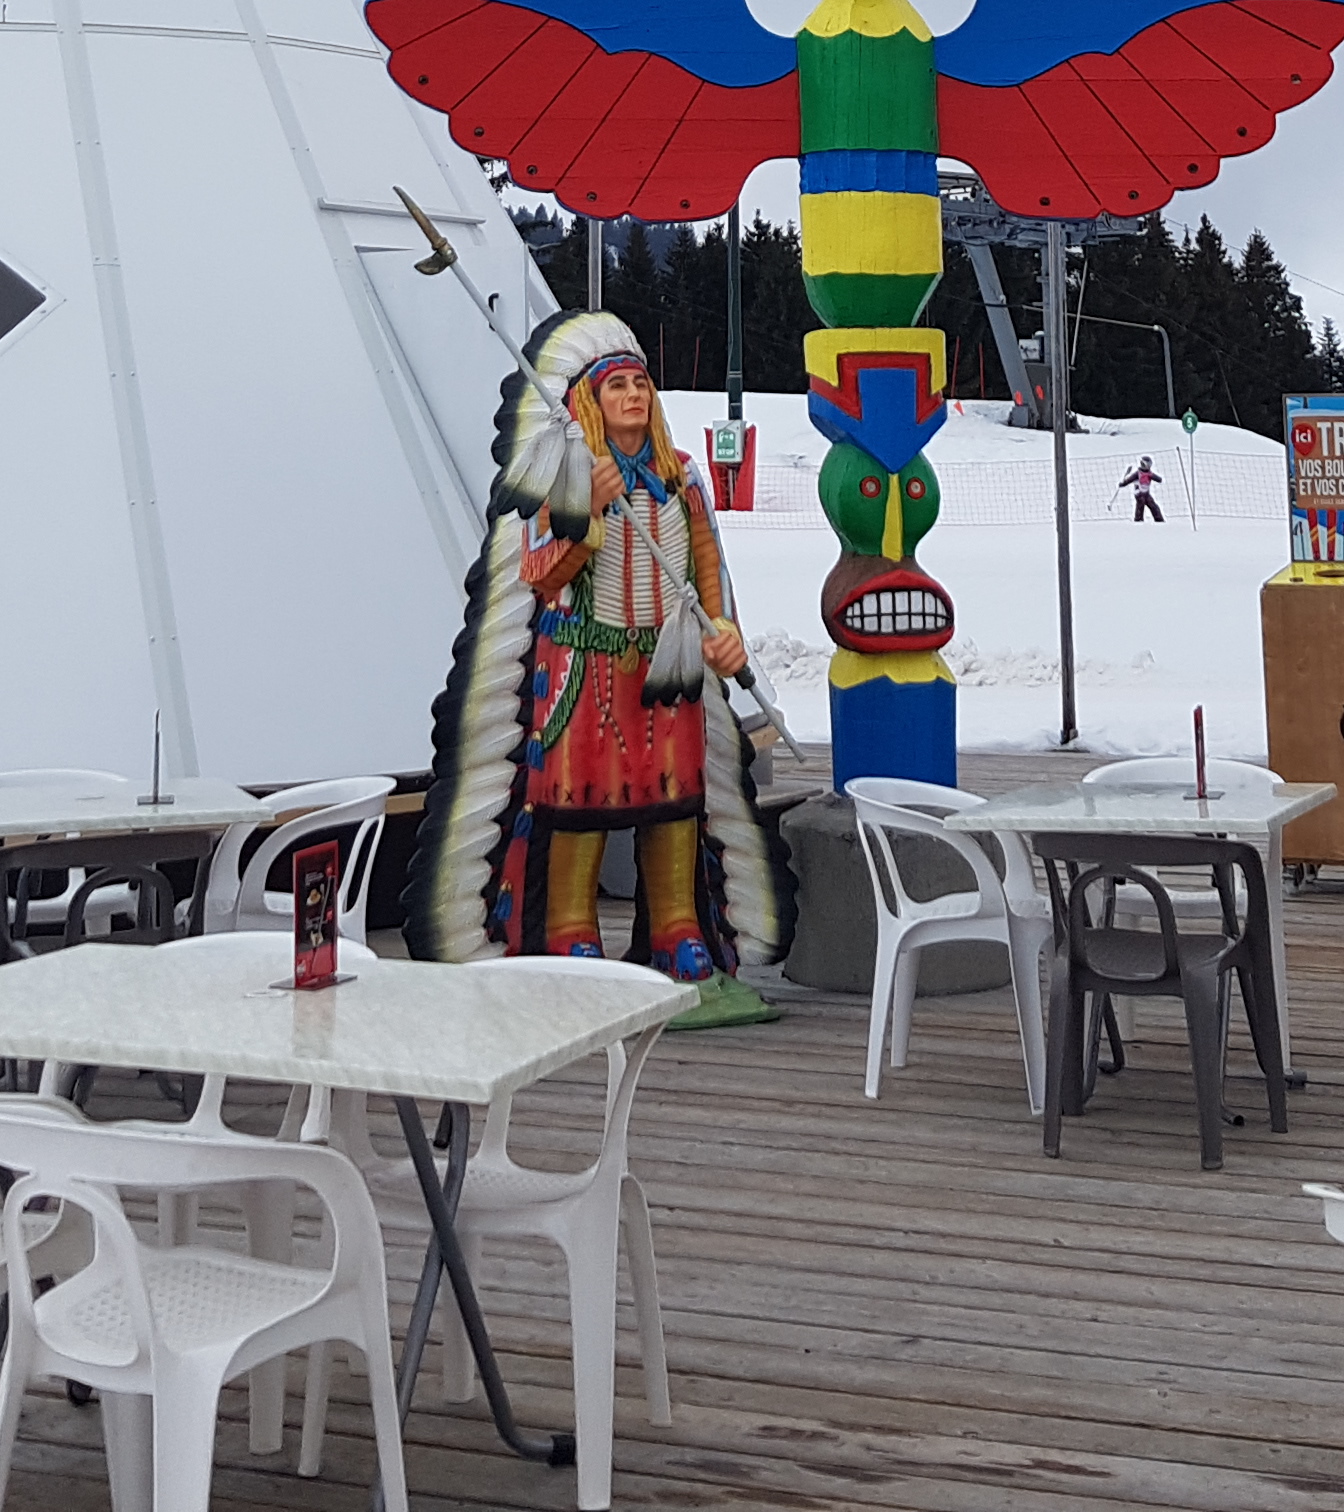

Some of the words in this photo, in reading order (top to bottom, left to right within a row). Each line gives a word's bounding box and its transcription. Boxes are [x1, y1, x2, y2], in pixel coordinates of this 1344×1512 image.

[1295, 428, 1312, 443] ici
[1298, 458, 1322, 477] VOS
[1298, 478, 1313, 496] ET
[1314, 478, 1337, 496] VOS
